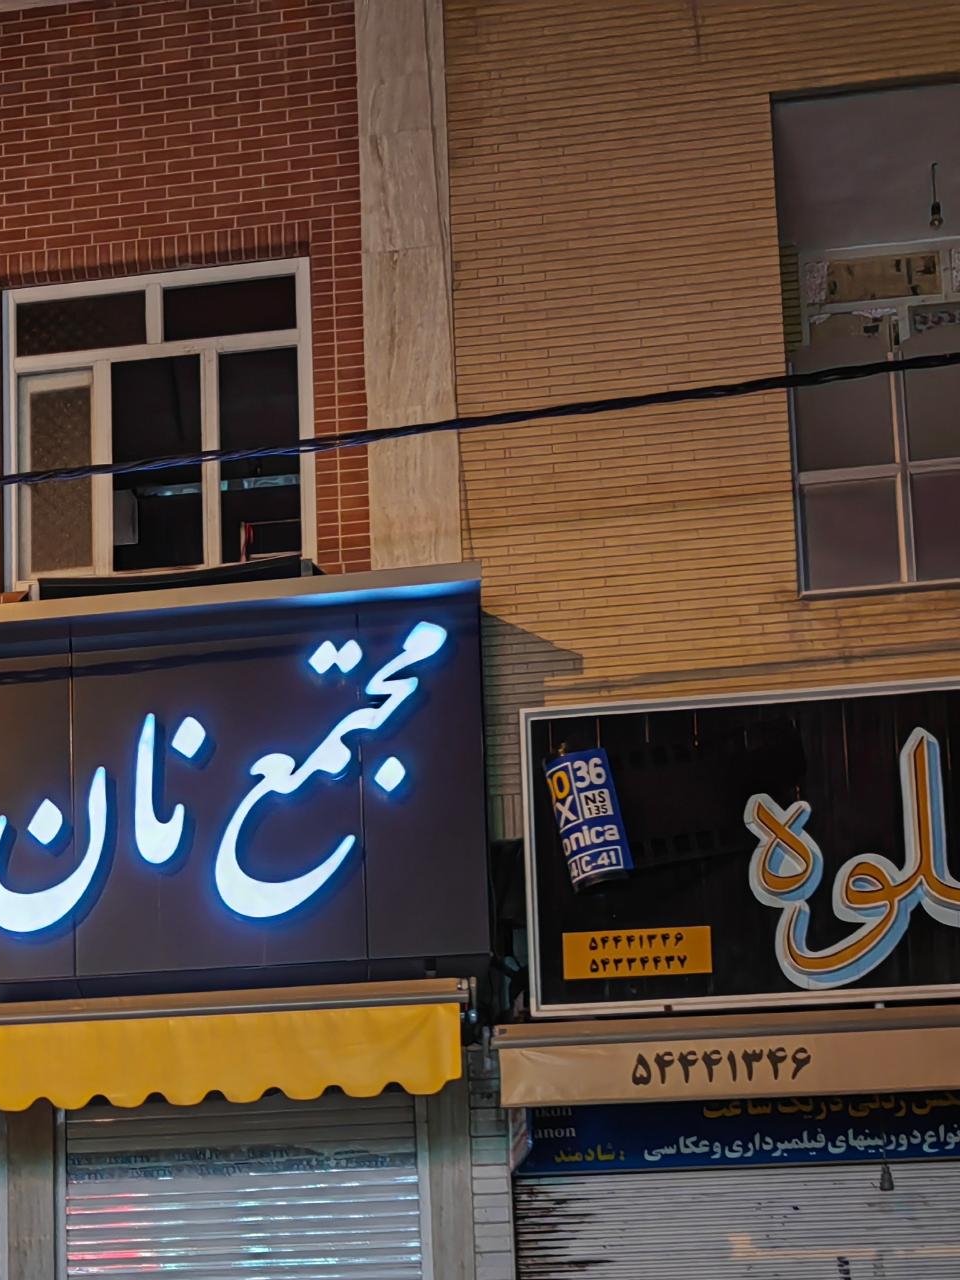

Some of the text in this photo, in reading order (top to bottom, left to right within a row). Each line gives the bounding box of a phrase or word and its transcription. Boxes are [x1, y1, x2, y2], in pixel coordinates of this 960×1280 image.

[215, 621, 447, 918] مجتمع
[572, 757, 607, 789] 36
[584, 790, 606, 806] NS
[586, 804, 608, 817] 135
[562, 824, 621, 857] onica
[580, 850, 618, 873] C-41
[743, 727, 960, 990] لوه
[589, 932, 684, 951] ۵۴۴۴۱۳۴۶
[631, 1046, 812, 1086] ۵۴۴۴۱۳۴۶
[533, 1126, 577, 1140] anon
[724, 1127, 827, 1160] فیلمبرداری
[922, 1123, 960, 1154] نواع
